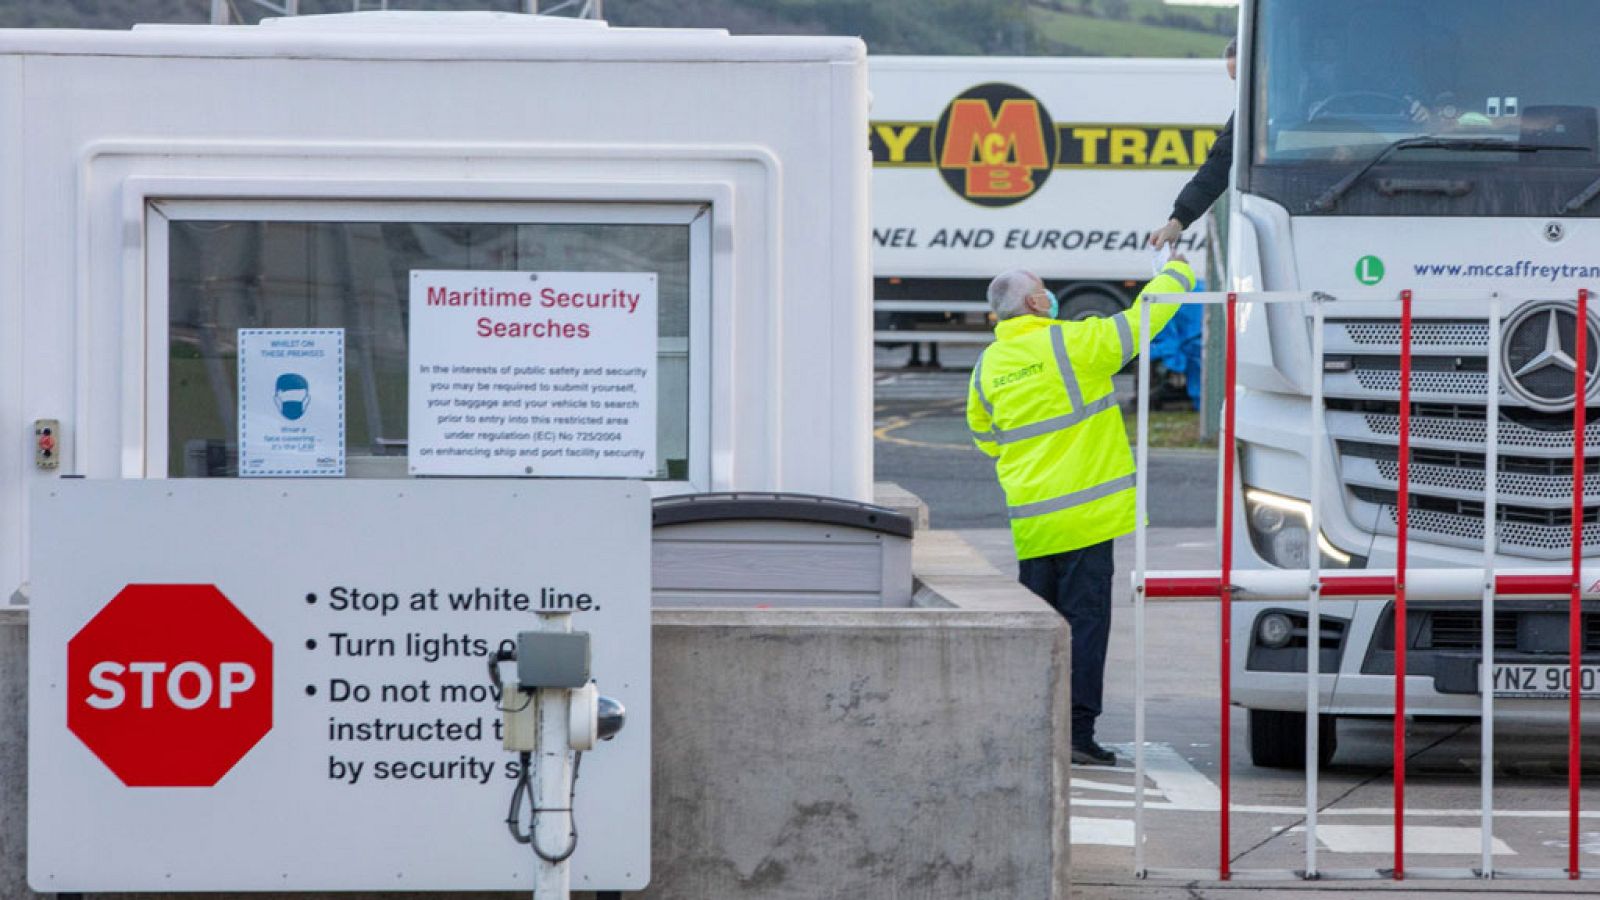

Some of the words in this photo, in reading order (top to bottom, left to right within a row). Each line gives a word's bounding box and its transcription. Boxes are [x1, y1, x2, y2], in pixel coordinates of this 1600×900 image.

[869, 126, 920, 162] Y
[928, 228, 994, 248] AND
[1361, 259, 1378, 281] L
[427, 286, 532, 307] Maritime
[540, 288, 640, 313] Security
[477, 317, 590, 338] Searches
[420, 365, 429, 373] In
[433, 365, 449, 373] the
[452, 365, 497, 374] interests
[500, 365, 511, 374] of
[514, 366, 545, 376] public
[549, 366, 579, 377] safety
[583, 367, 602, 376] and
[606, 367, 647, 377] security
[992, 362, 1044, 388] SECURITY
[430, 383, 449, 392] you
[453, 383, 475, 392] may
[478, 382, 490, 391] be
[493, 382, 536, 392] required
[540, 383, 550, 391] to
[553, 382, 588, 392] submit
[592, 384, 636, 393] yourself,
[428, 399, 451, 408] your
[454, 398, 499, 408] baggage
[503, 399, 521, 407] and
[525, 400, 548, 408] your
[551, 399, 587, 408] vehicle
[591, 400, 601, 408] to
[604, 400, 639, 408] search
[438, 415, 462, 425] prior
[466, 415, 475, 423] to
[479, 415, 505, 425] entry
[508, 415, 528, 424] into
[531, 415, 550, 424] this
[553, 416, 602, 425] restricted
[606, 417, 628, 425] area
[444, 431, 474, 440] under
[478, 431, 530, 442] regulation
[533, 432, 555, 442] (EC)
[559, 432, 573, 440] No
[576, 432, 621, 441] 725/2004
[420, 448, 433, 456] on
[436, 447, 491, 457] enhancing
[494, 448, 516, 458] ship
[519, 448, 538, 457] and
[542, 448, 562, 458] port
[565, 448, 600, 458] facility
[603, 449, 644, 459] security
[328, 587, 399, 616] Stop
[410, 589, 439, 611] at
[450, 587, 530, 611] white
[540, 587, 601, 611] line.
[328, 633, 395, 657] Turn
[406, 633, 489, 663] lights
[86, 660, 256, 710] STOP
[1492, 667, 1537, 690] YNZ
[1546, 668, 1600, 690] 900
[329, 679, 370, 702] Do
[382, 680, 431, 702] not
[328, 717, 483, 741] instructed
[328, 756, 364, 785] by
[374, 757, 495, 785] security
